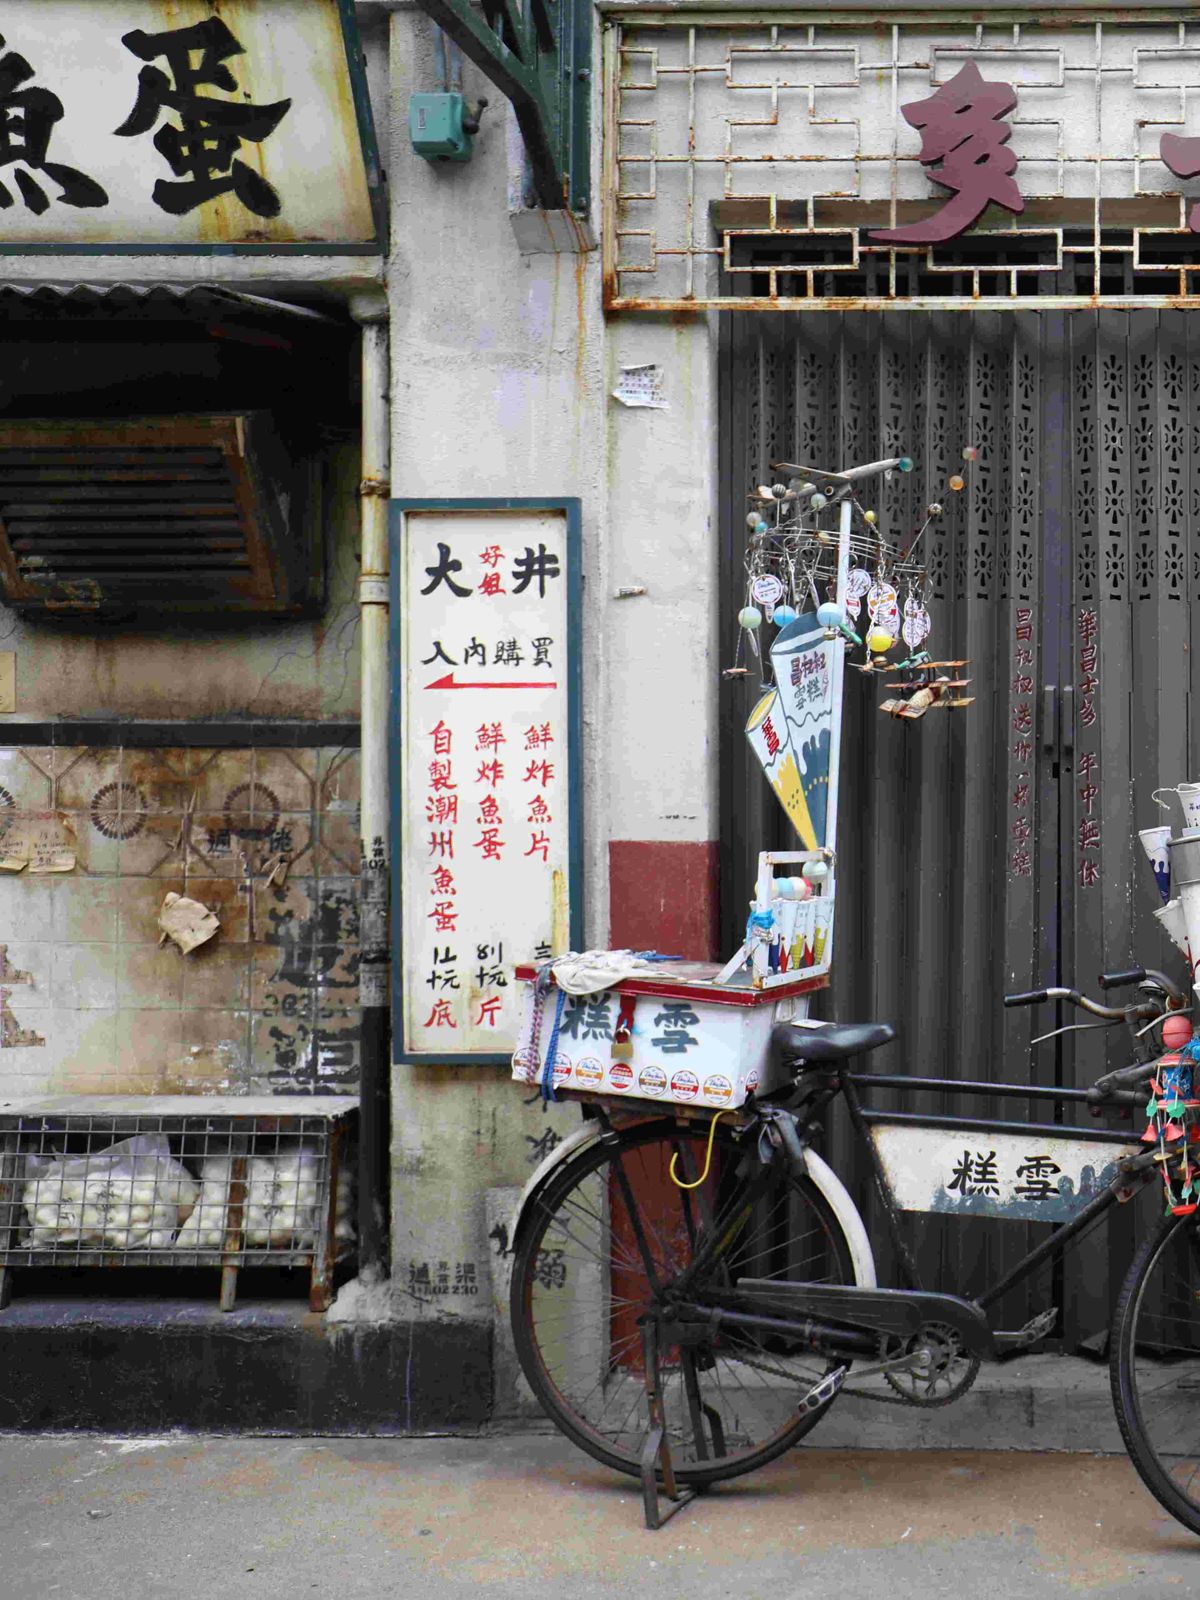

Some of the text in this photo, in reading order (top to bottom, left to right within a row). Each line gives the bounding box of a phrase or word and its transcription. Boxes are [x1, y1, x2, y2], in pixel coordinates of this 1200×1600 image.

[421, 636, 554, 669] 入內購買
[426, 719, 460, 935] 自製潮州魚蛋
[473, 722, 506, 862] 鮮炸魚蛋
[522, 722, 555, 863] 鮮炸魚片
[558, 990, 701, 1055] 雪糕
[946, 1149, 1063, 1201] 雪糕
